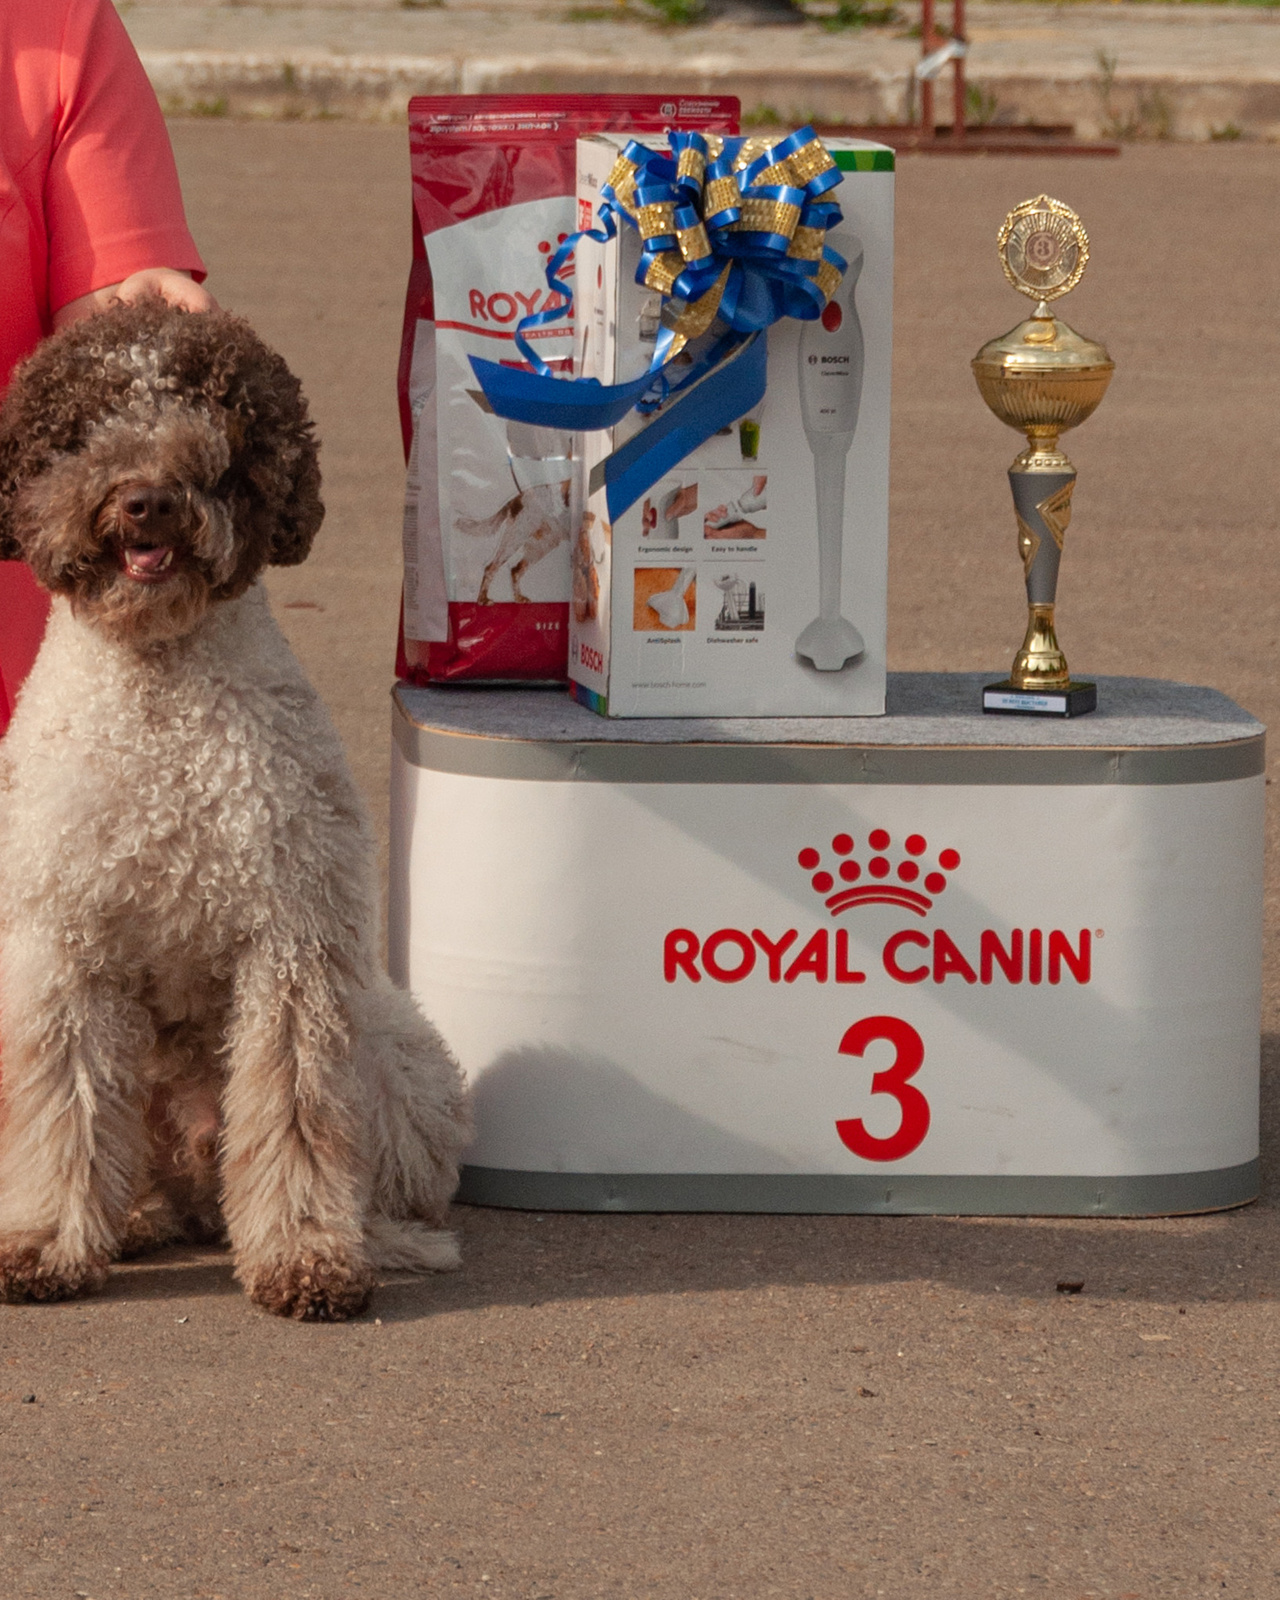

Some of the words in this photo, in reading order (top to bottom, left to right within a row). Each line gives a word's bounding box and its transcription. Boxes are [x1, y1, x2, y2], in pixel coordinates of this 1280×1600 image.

[821, 356, 850, 364] BOSCH
[638, 546, 671, 554] Ergonomic
[672, 545, 693, 554] design
[711, 546, 726, 554] Easy
[535, 622, 560, 631] SIZE
[580, 643, 604, 674] BOSCH
[663, 928, 867, 984] ROYAL
[882, 928, 1092, 985] CANIN
[834, 1015, 931, 1162] 3
